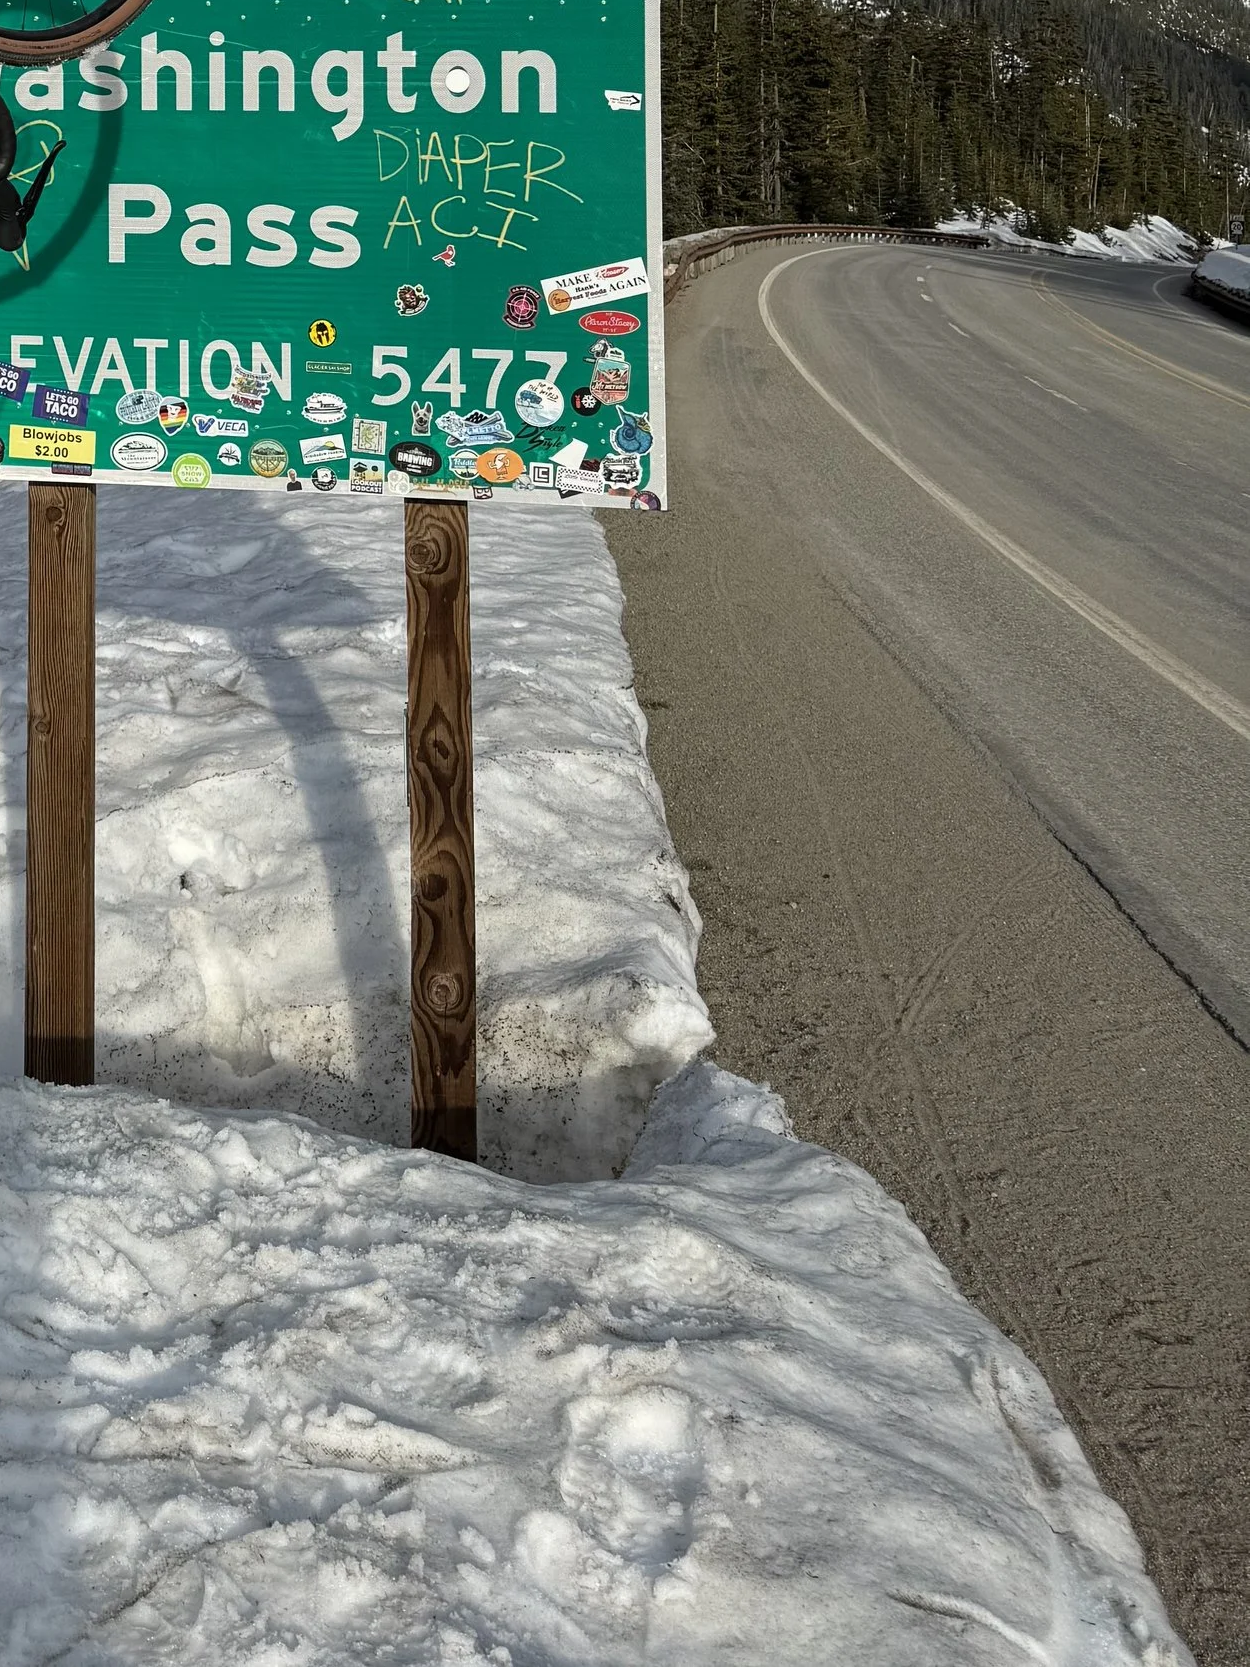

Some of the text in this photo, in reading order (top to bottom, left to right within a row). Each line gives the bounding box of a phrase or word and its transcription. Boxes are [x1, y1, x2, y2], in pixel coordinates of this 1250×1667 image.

[108, 184, 361, 269] Pass
[555, 273, 592, 289] MAKE
[609, 275, 647, 292] AGAIN
[7, 370, 20, 381] GO
[371, 345, 568, 410] 5477
[45, 391, 80, 406] LET'S GO
[45, 400, 79, 418] TACO
[217, 421, 247, 432] VECA
[23, 428, 83, 444] Blowjobs
[35, 444, 69, 458] $2.00
[351, 479, 382, 487] LOOKOUT
[351, 485, 382, 493] PODCAST
